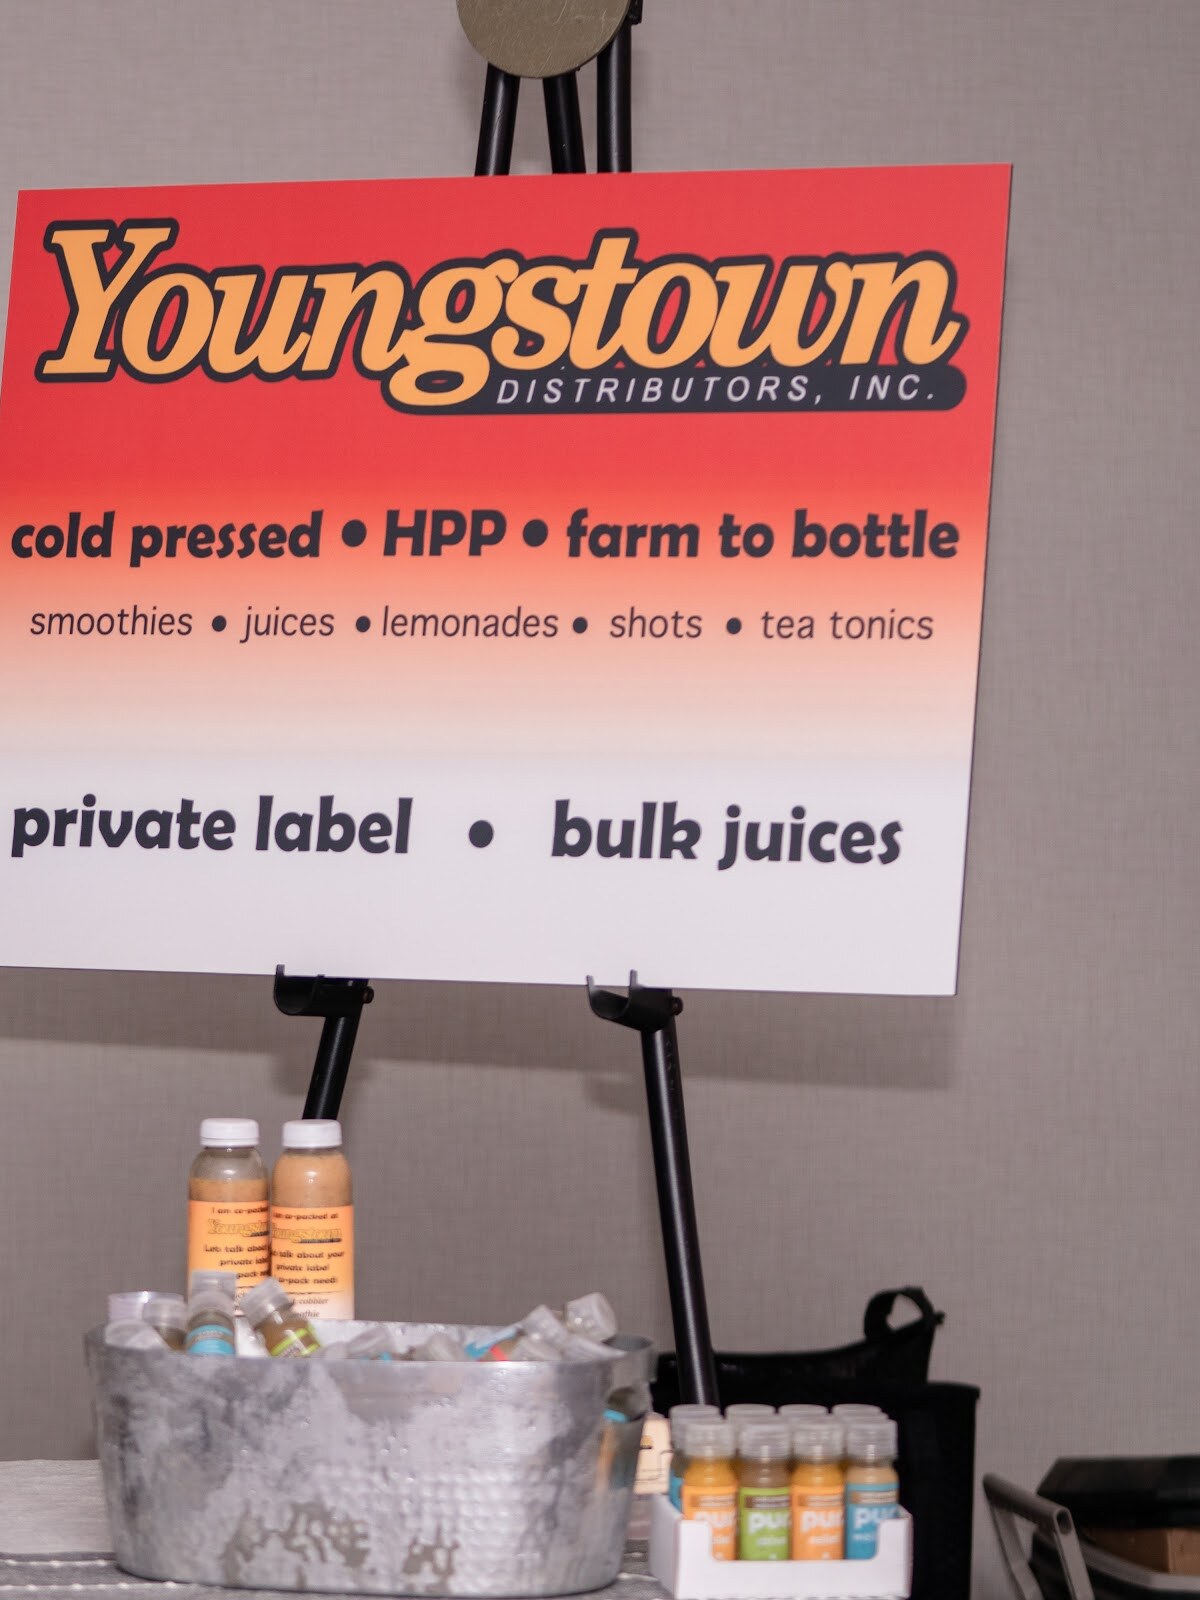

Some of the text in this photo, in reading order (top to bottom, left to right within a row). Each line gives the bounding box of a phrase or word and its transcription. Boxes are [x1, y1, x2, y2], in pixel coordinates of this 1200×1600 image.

[39, 226, 963, 408] Youngstown
[496, 374, 936, 404] DISTRIBUTORS, INC.
[11, 508, 959, 568] cold pressed HPP farm to bottle
[30, 604, 933, 644] smoothies juices lemonades shots tea tonics
[11, 793, 902, 871] private label bulk juices
